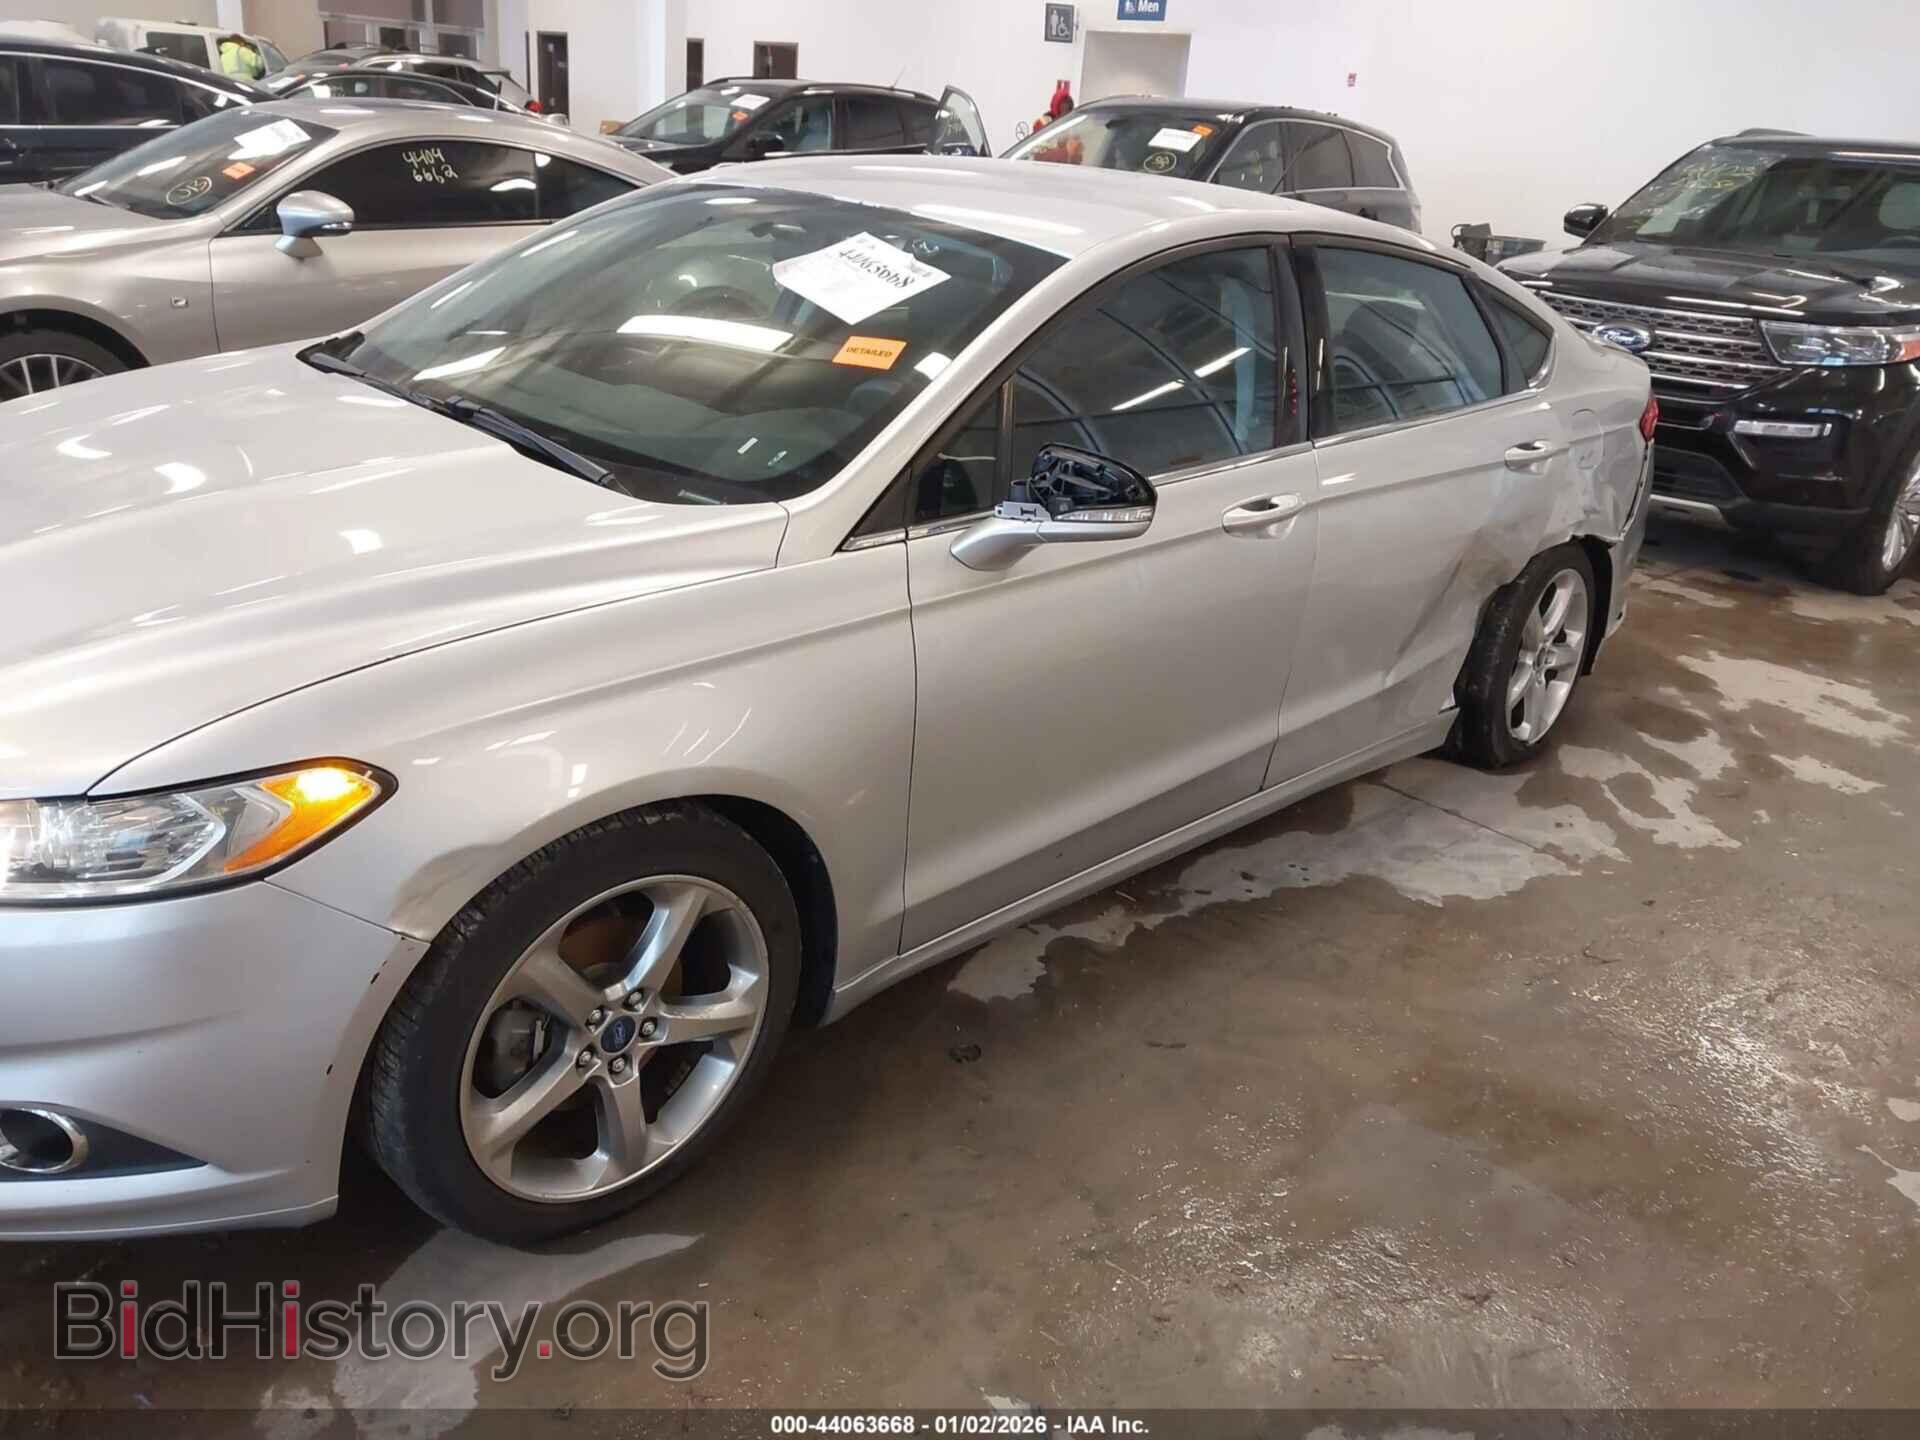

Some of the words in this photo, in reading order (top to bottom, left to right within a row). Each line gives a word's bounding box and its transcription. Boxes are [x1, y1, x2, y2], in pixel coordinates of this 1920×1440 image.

[1138, 0, 1160, 13] Men
[402, 147, 446, 169] 4404
[412, 164, 459, 184] 6662
[846, 346, 893, 358] DETAILED
